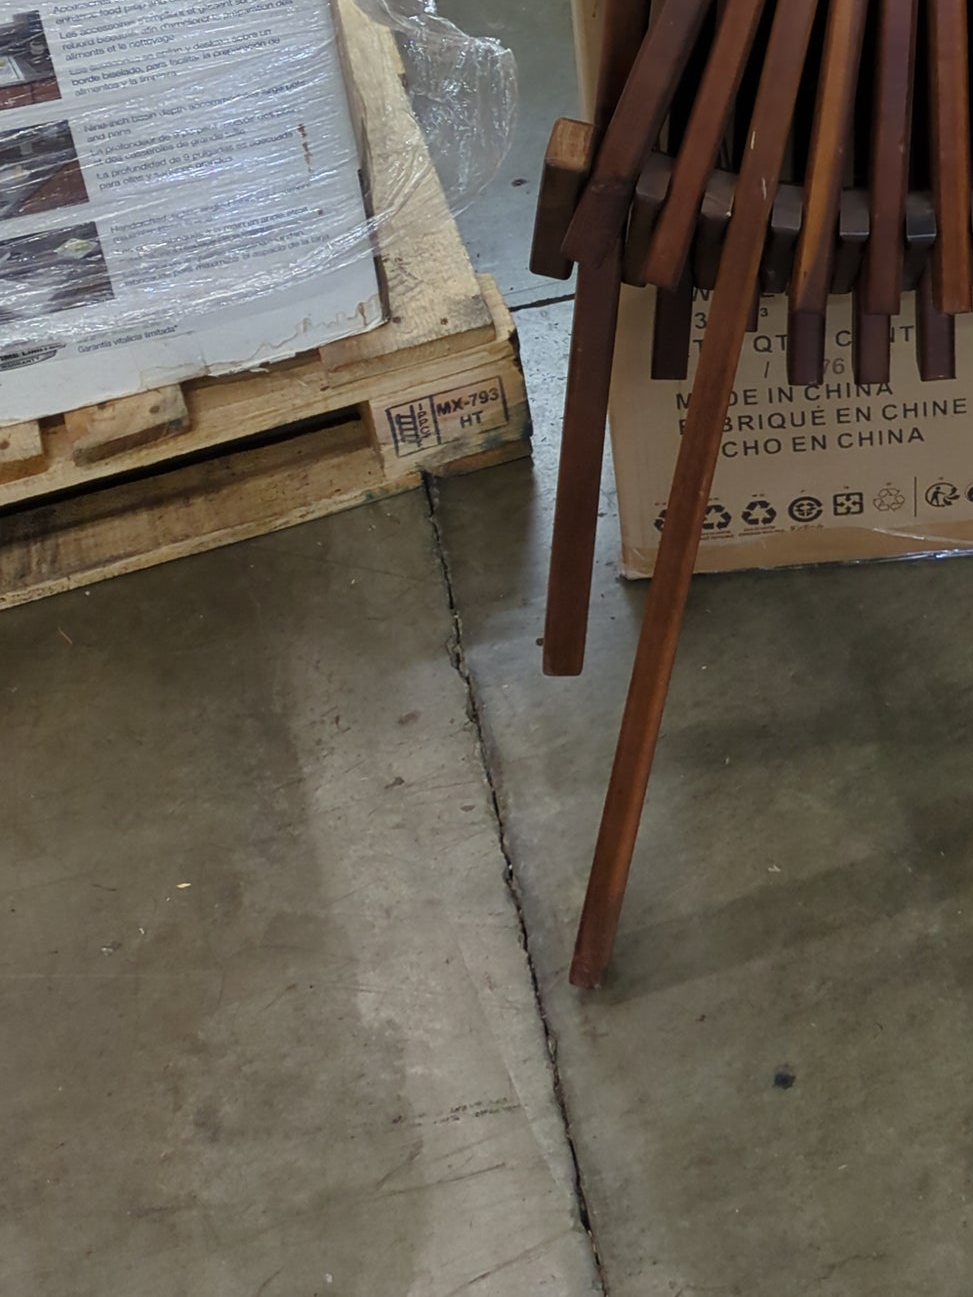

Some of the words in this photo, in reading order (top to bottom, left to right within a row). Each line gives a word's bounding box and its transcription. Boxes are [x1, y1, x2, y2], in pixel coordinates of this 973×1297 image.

[77, 339, 113, 355] Garantía
[435, 387, 500, 417] MX-793
[676, 388, 759, 410] MDE
[768, 386, 795, 405] IN
[804, 381, 894, 402] CHINA
[460, 410, 484, 429] HT
[836, 405, 873, 425] EN
[881, 398, 970, 421] CHINE
[791, 434, 828, 453] EN
[837, 426, 926, 450] CHINA
